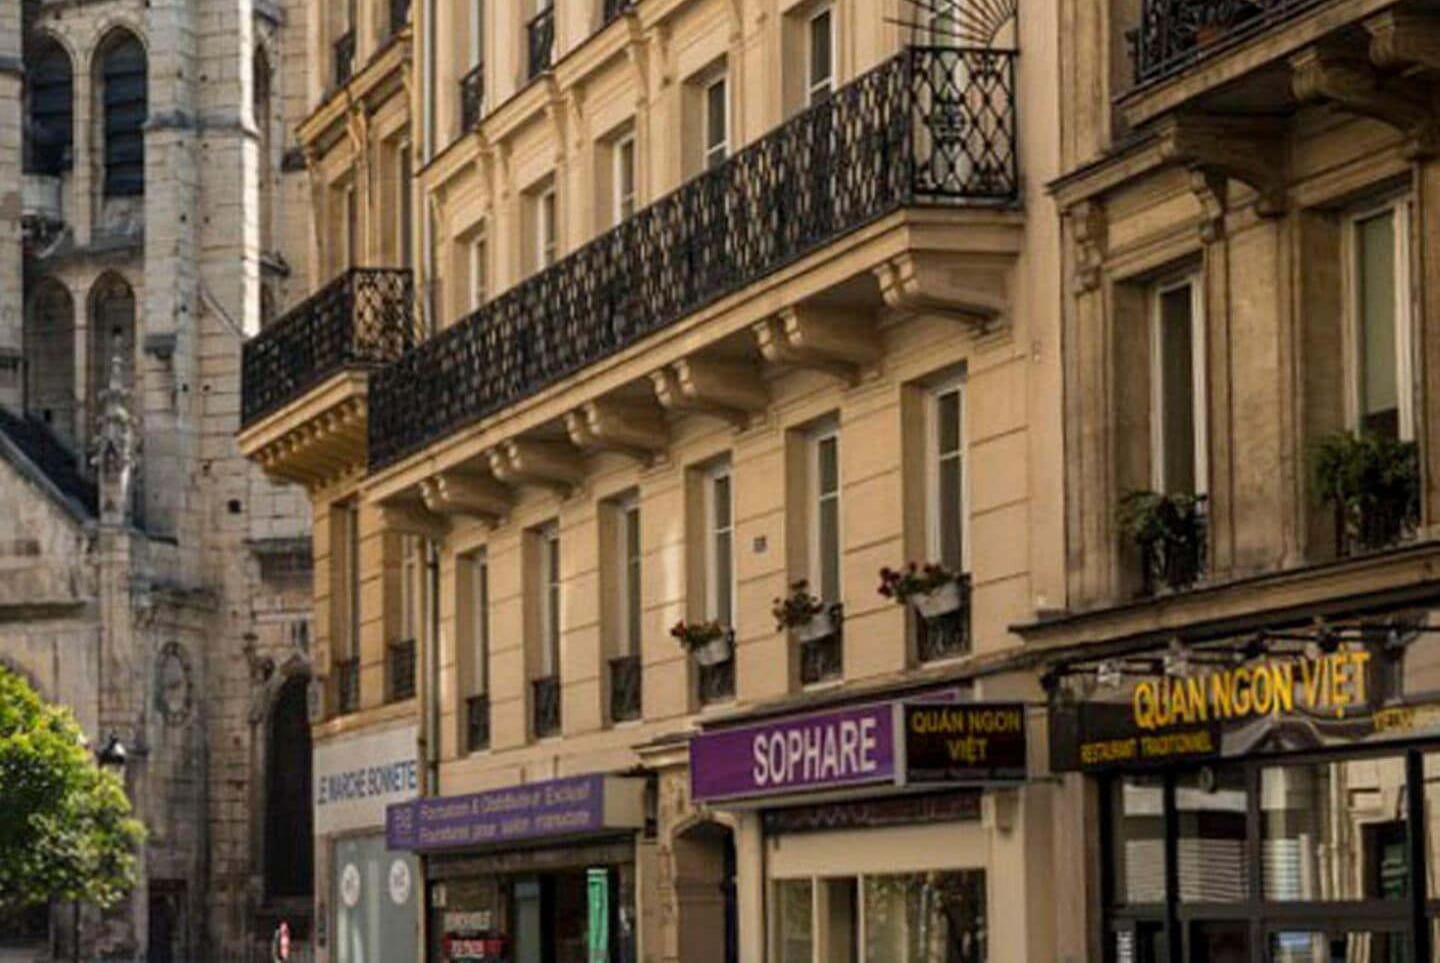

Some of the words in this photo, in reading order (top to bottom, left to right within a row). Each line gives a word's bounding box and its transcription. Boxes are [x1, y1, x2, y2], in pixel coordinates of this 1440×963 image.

[1213, 660, 1294, 719] NGON
[967, 710, 1019, 732] NGON
[753, 717, 877, 786] SOPHARE
